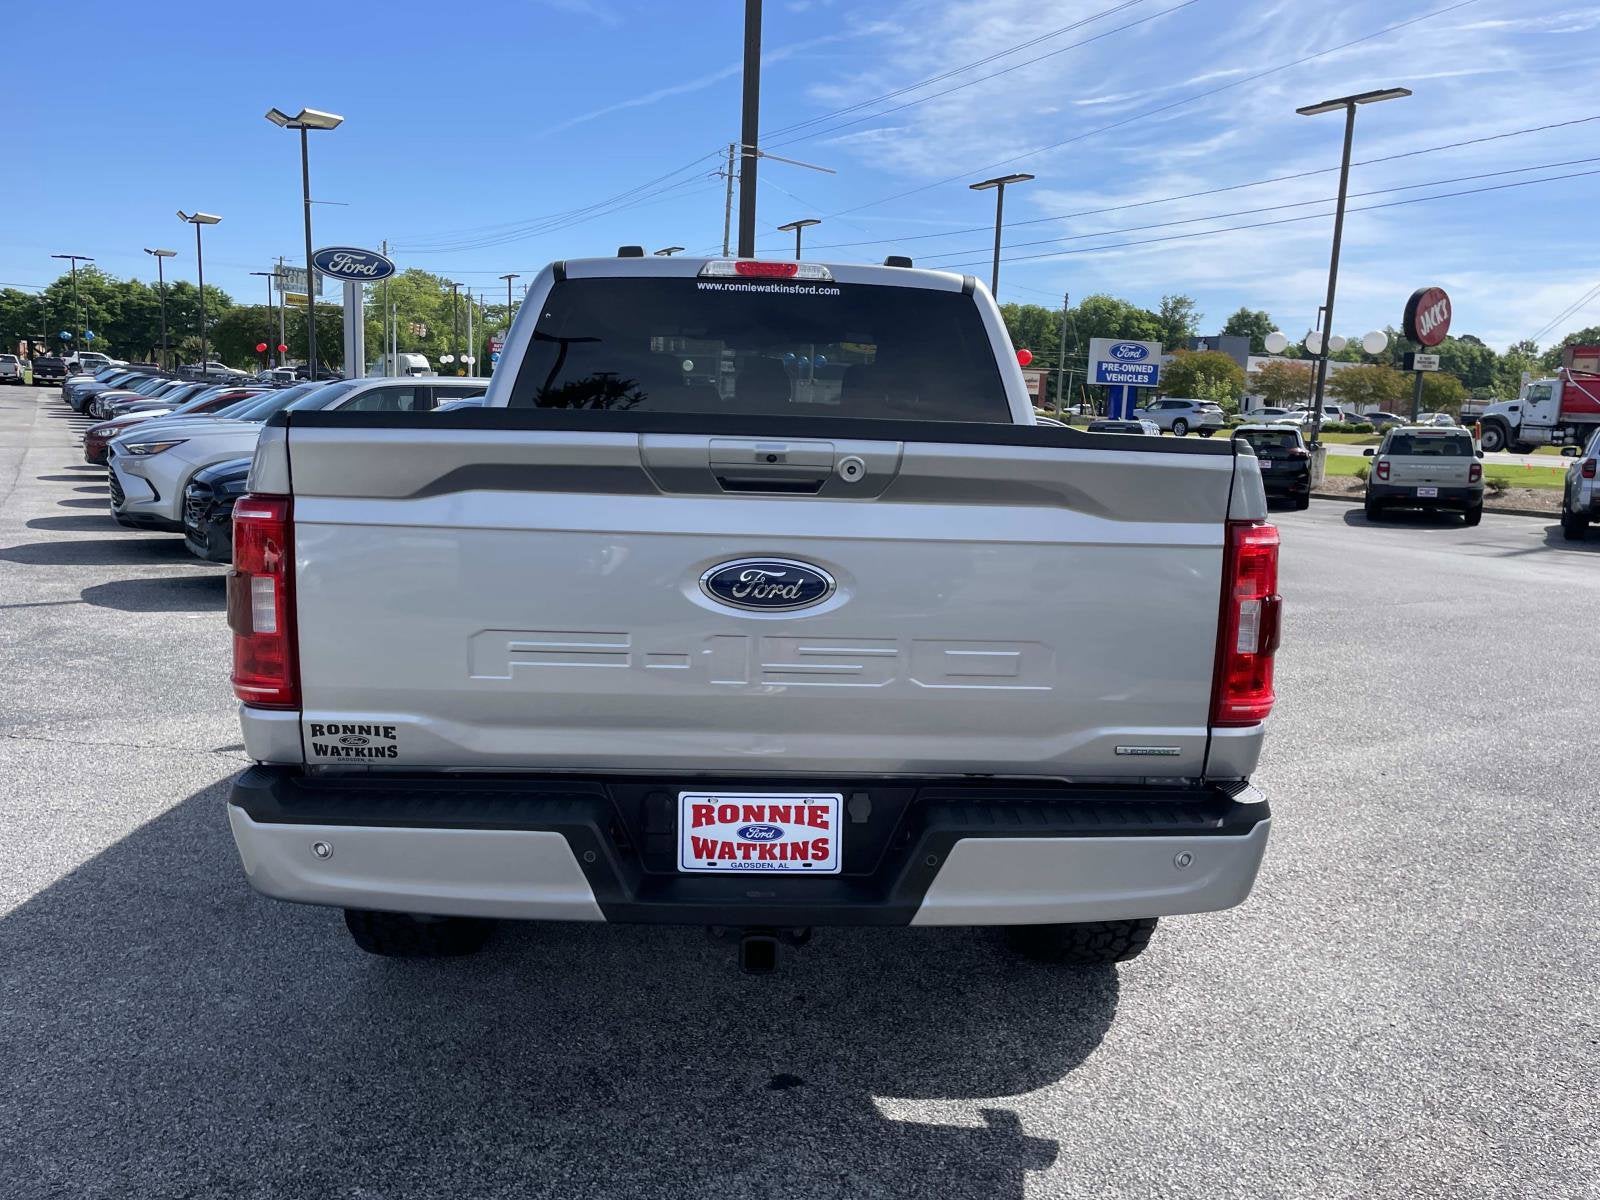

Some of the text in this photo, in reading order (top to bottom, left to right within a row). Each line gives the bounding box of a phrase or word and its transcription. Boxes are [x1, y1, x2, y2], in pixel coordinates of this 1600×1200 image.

[328, 252, 378, 275] Ford
[696, 281, 841, 296] www.ronniewatkinsford.com
[1116, 344, 1142, 358] Ford
[1102, 362, 1154, 374] PRE-OWNED
[1105, 373, 1149, 383] VEHICLES
[731, 567, 803, 601] Ford
[467, 628, 1055, 690] F-150
[310, 723, 397, 740] RONNIE
[312, 742, 398, 759] WATKINS
[691, 803, 830, 830] RONNIE
[745, 826, 775, 839] Ford
[690, 835, 830, 862] WATKINS
[730, 862, 790, 870] GADSDEN, AL
